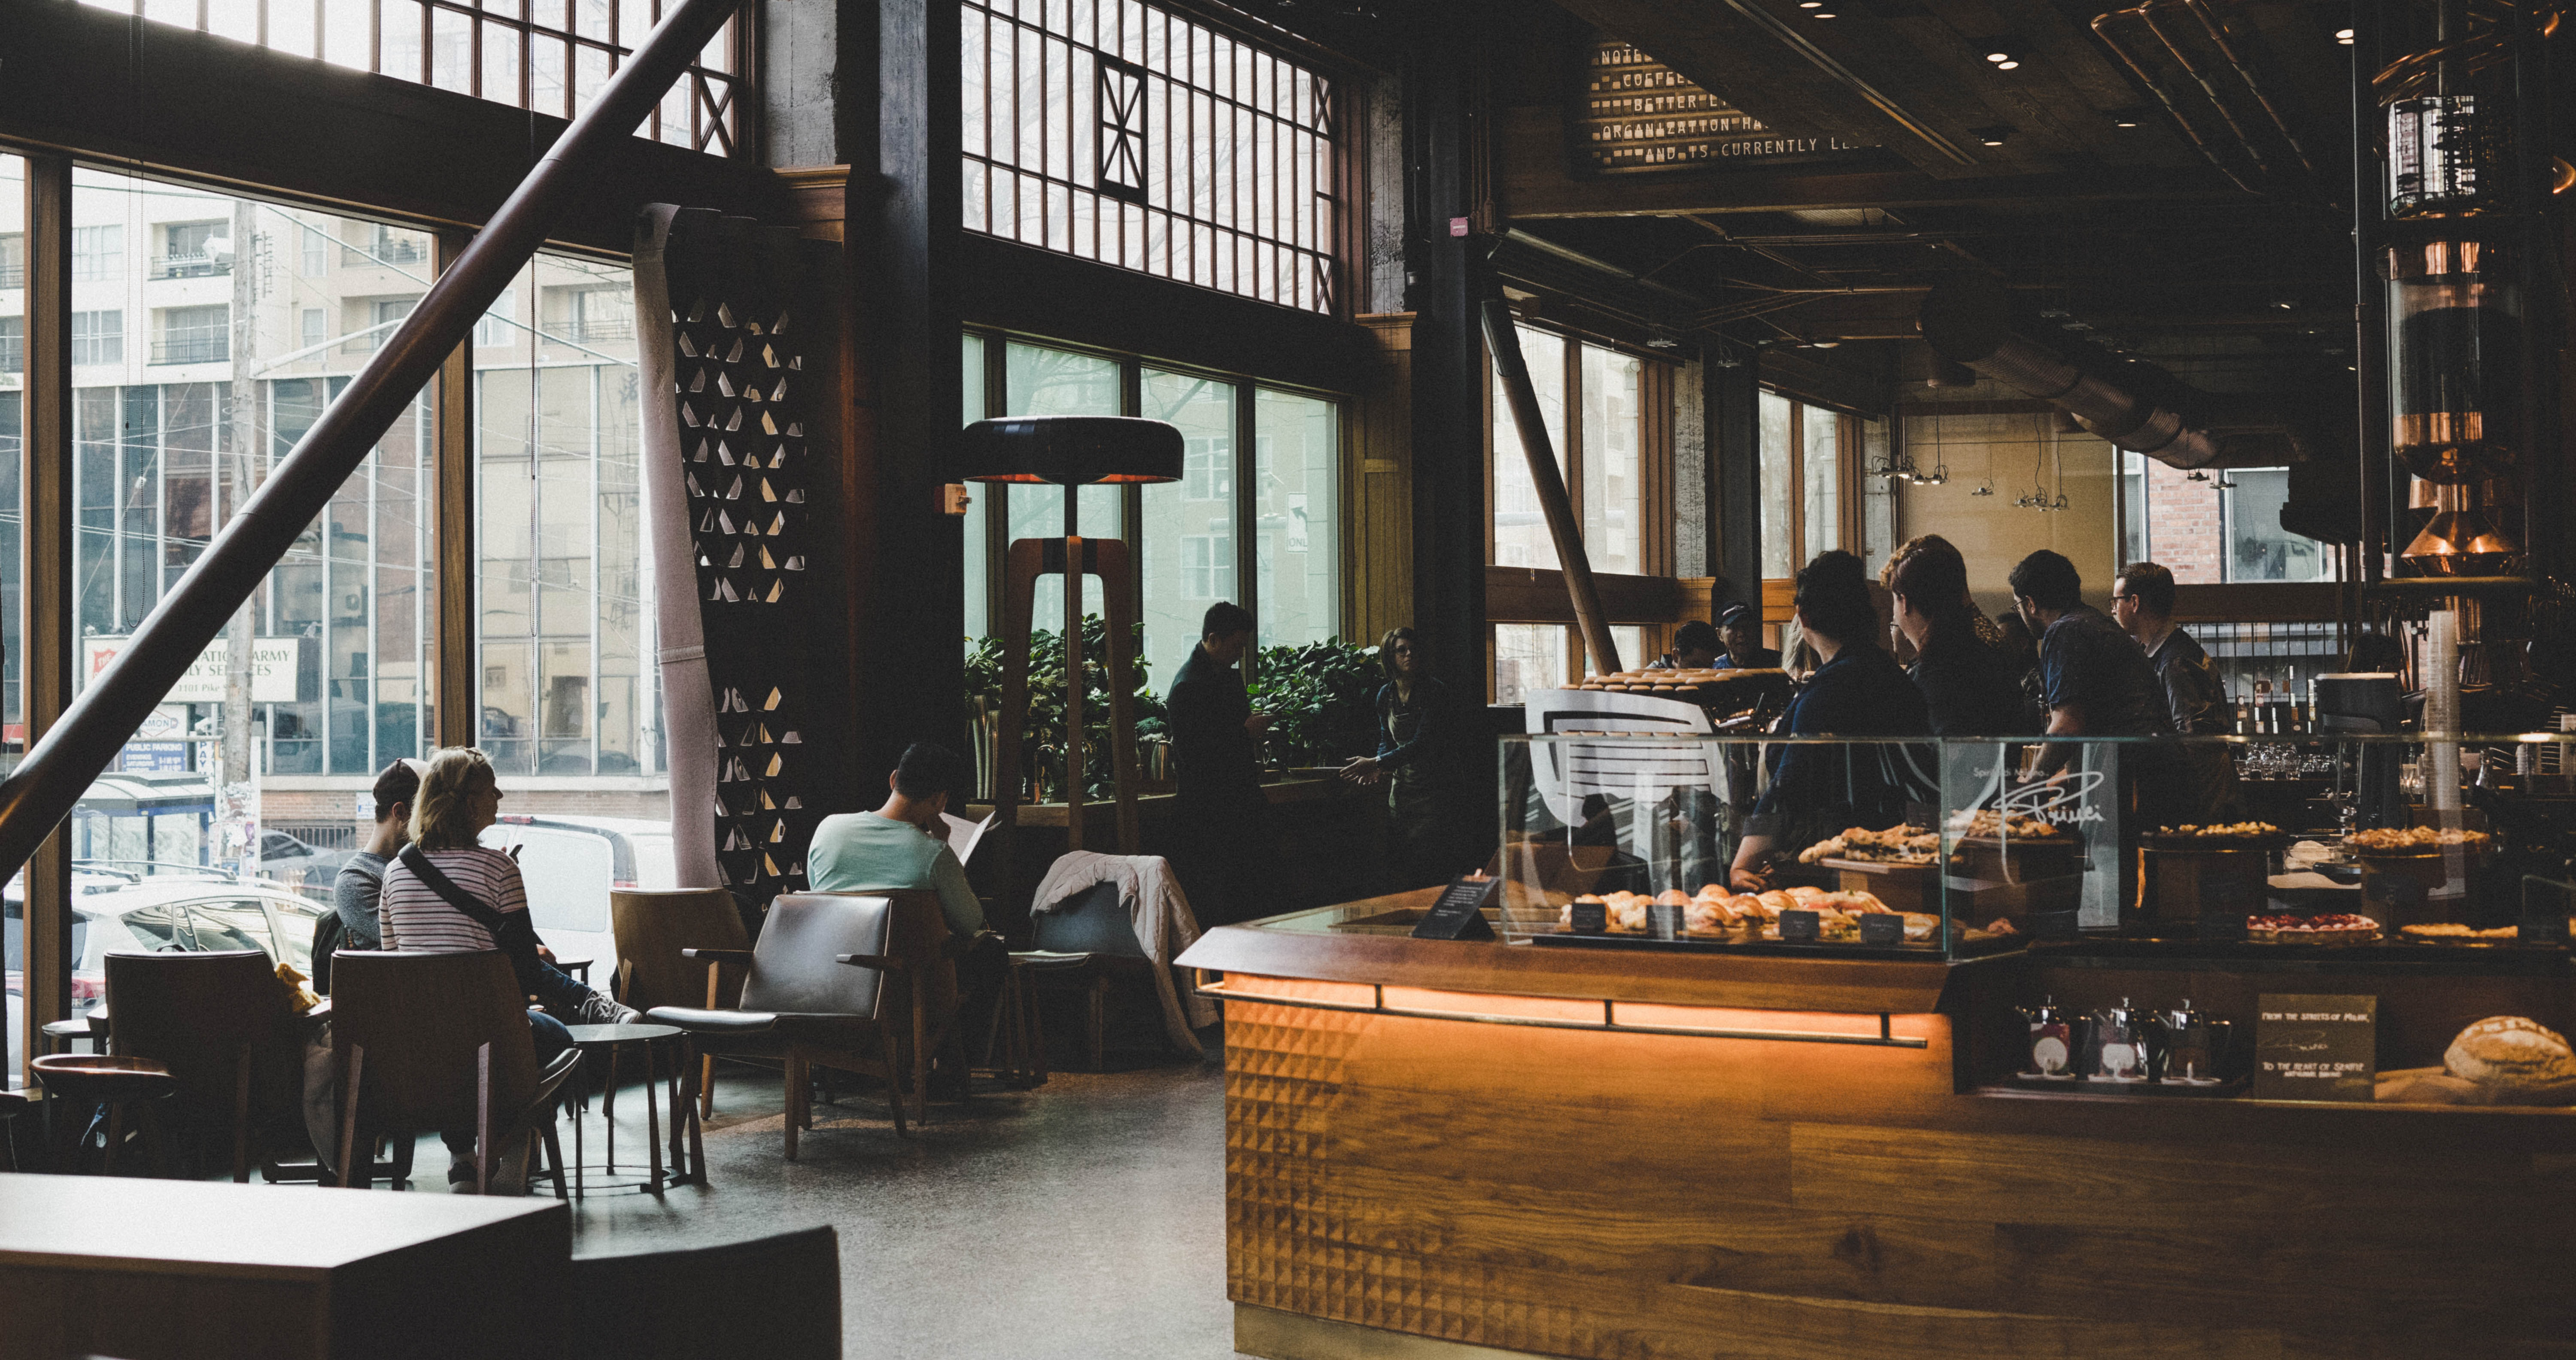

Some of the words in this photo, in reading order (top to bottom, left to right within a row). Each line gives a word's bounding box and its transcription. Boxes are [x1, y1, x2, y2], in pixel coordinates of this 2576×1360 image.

[1623, 72, 1685, 86] COFFEE
[1634, 95, 1696, 111] BETTER
[1603, 118, 1729, 138] ORGANIZATION
[1742, 116, 1769, 130] HA
[1646, 147, 1675, 161] AND
[1691, 145, 1707, 158] IS
[1722, 138, 1817, 156] CURRENTLY
[1289, 538, 1308, 547] ONL
[252, 650, 290, 662] ARMY
[202, 683, 220, 692] Pike
[142, 717, 179, 729] AMOND
[126, 743, 152, 752] PUBLIC
[152, 743, 183, 752] PARKING
